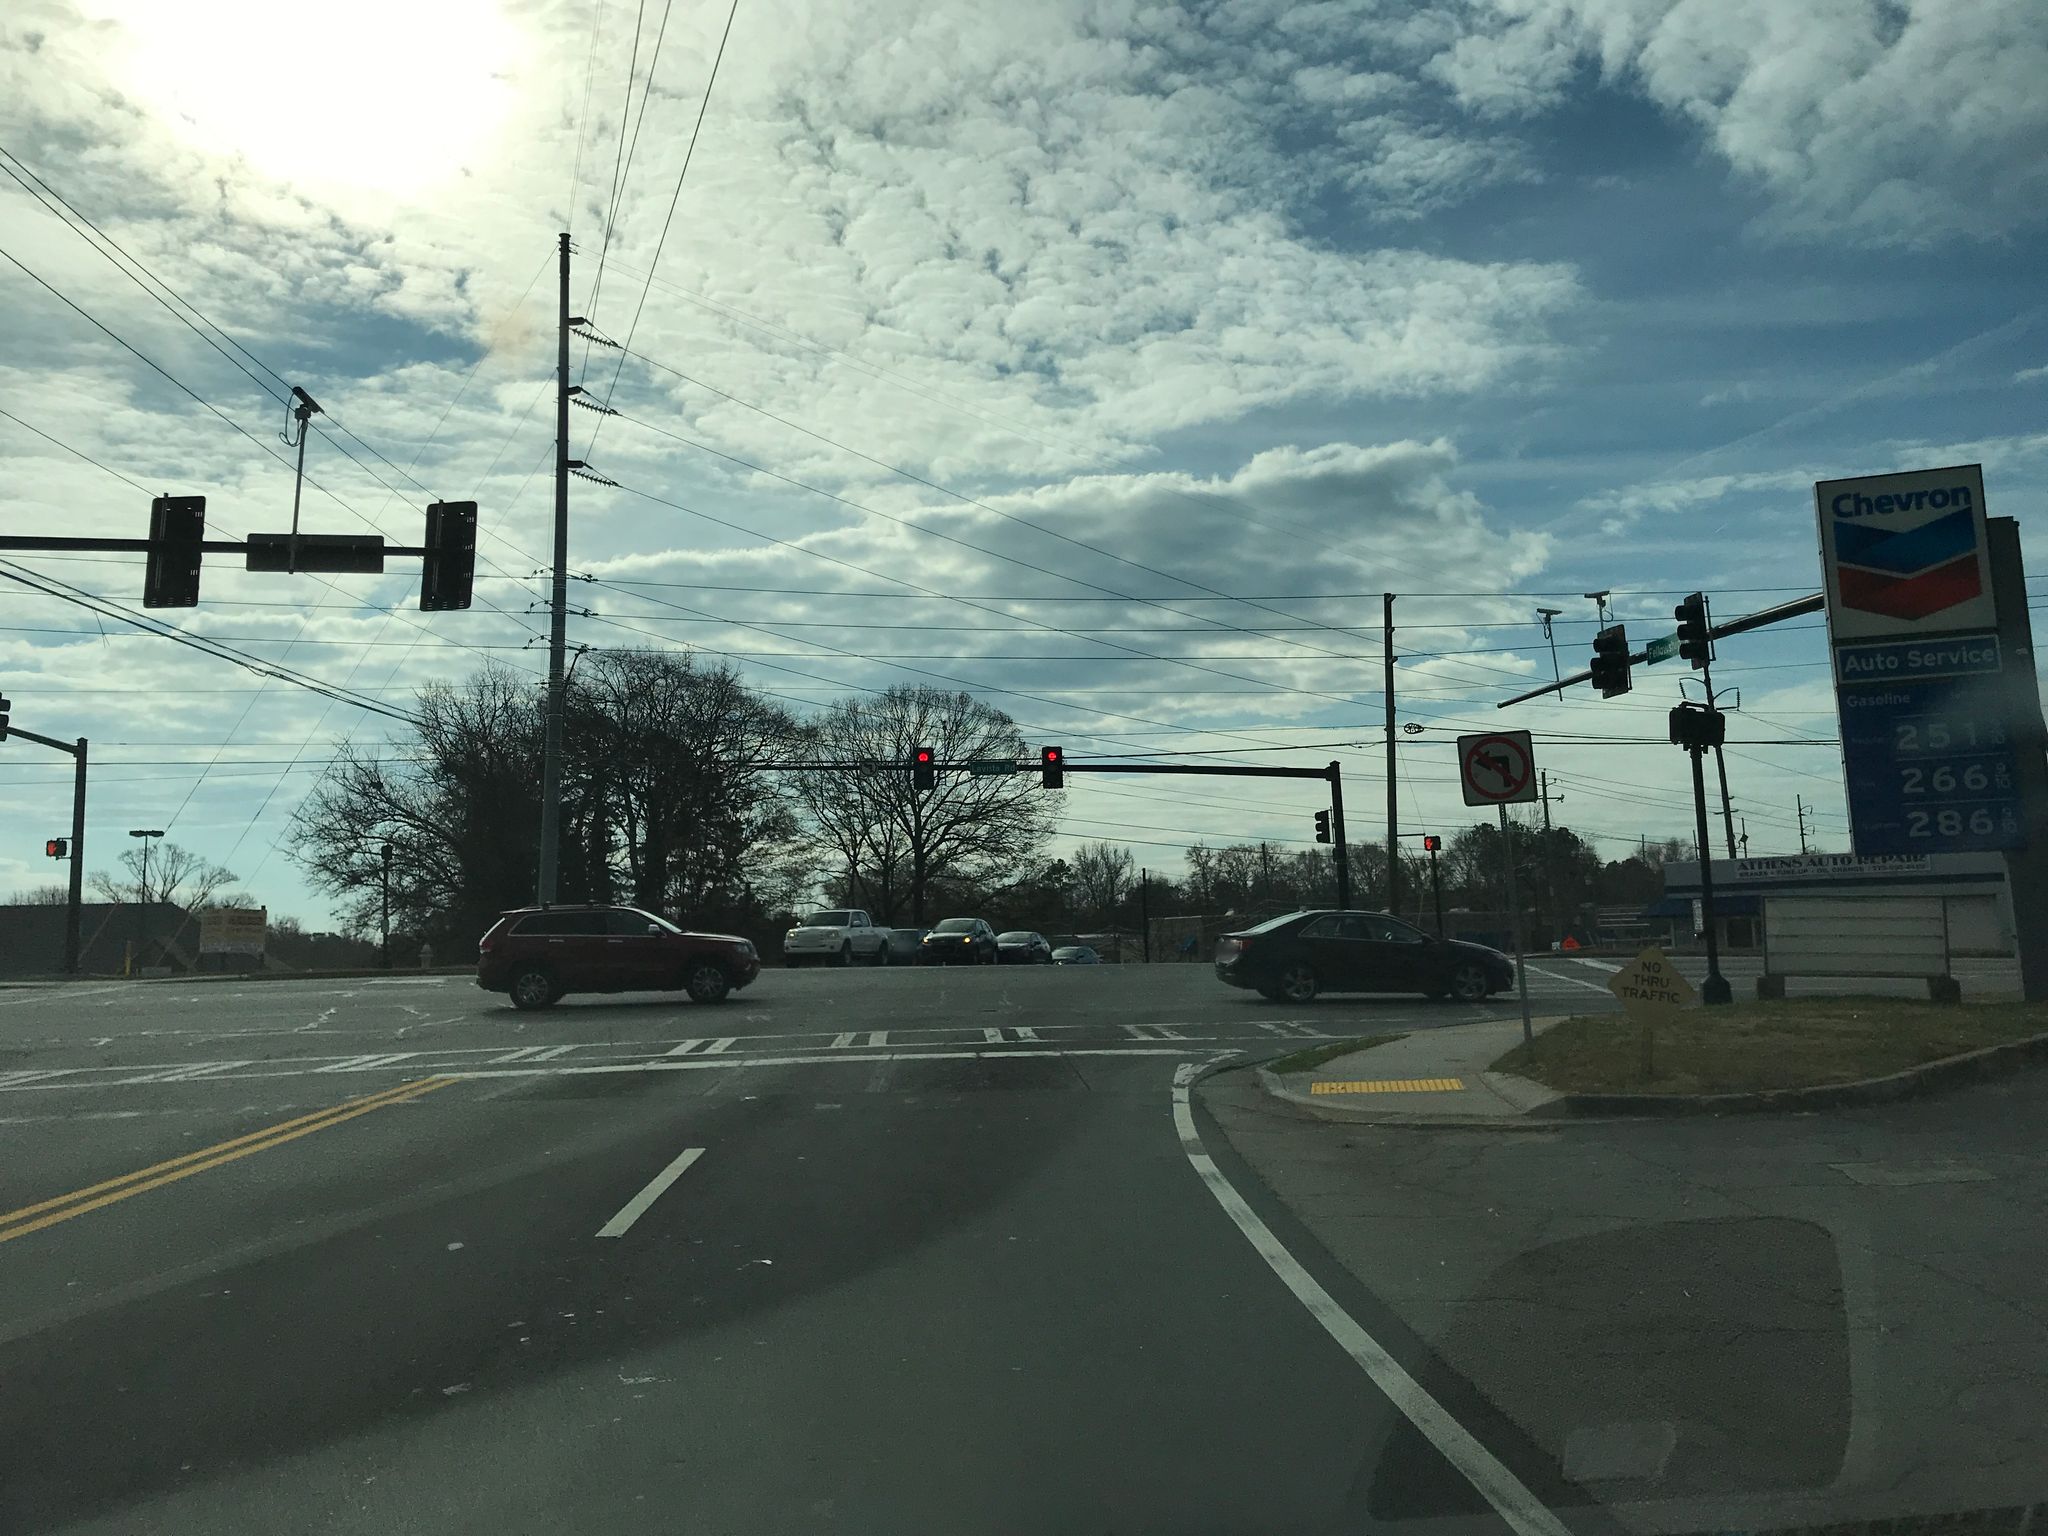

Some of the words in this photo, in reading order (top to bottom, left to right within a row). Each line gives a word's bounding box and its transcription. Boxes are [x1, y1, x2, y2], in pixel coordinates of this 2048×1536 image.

[1831, 485, 1972, 519] Chevron
[1845, 650, 1899, 673] Auto
[1907, 645, 1995, 669] Service
[1846, 692, 1911, 708] Gasoline
[1901, 764, 1988, 794] 266
[1906, 807, 1994, 838] 286
[1738, 858, 1802, 871] ATHENS
[1806, 855, 1852, 868] AUTO
[1641, 961, 1662, 973] NO
[1633, 974, 1670, 988] THRU
[1622, 987, 1680, 1004] TRAFFIC
